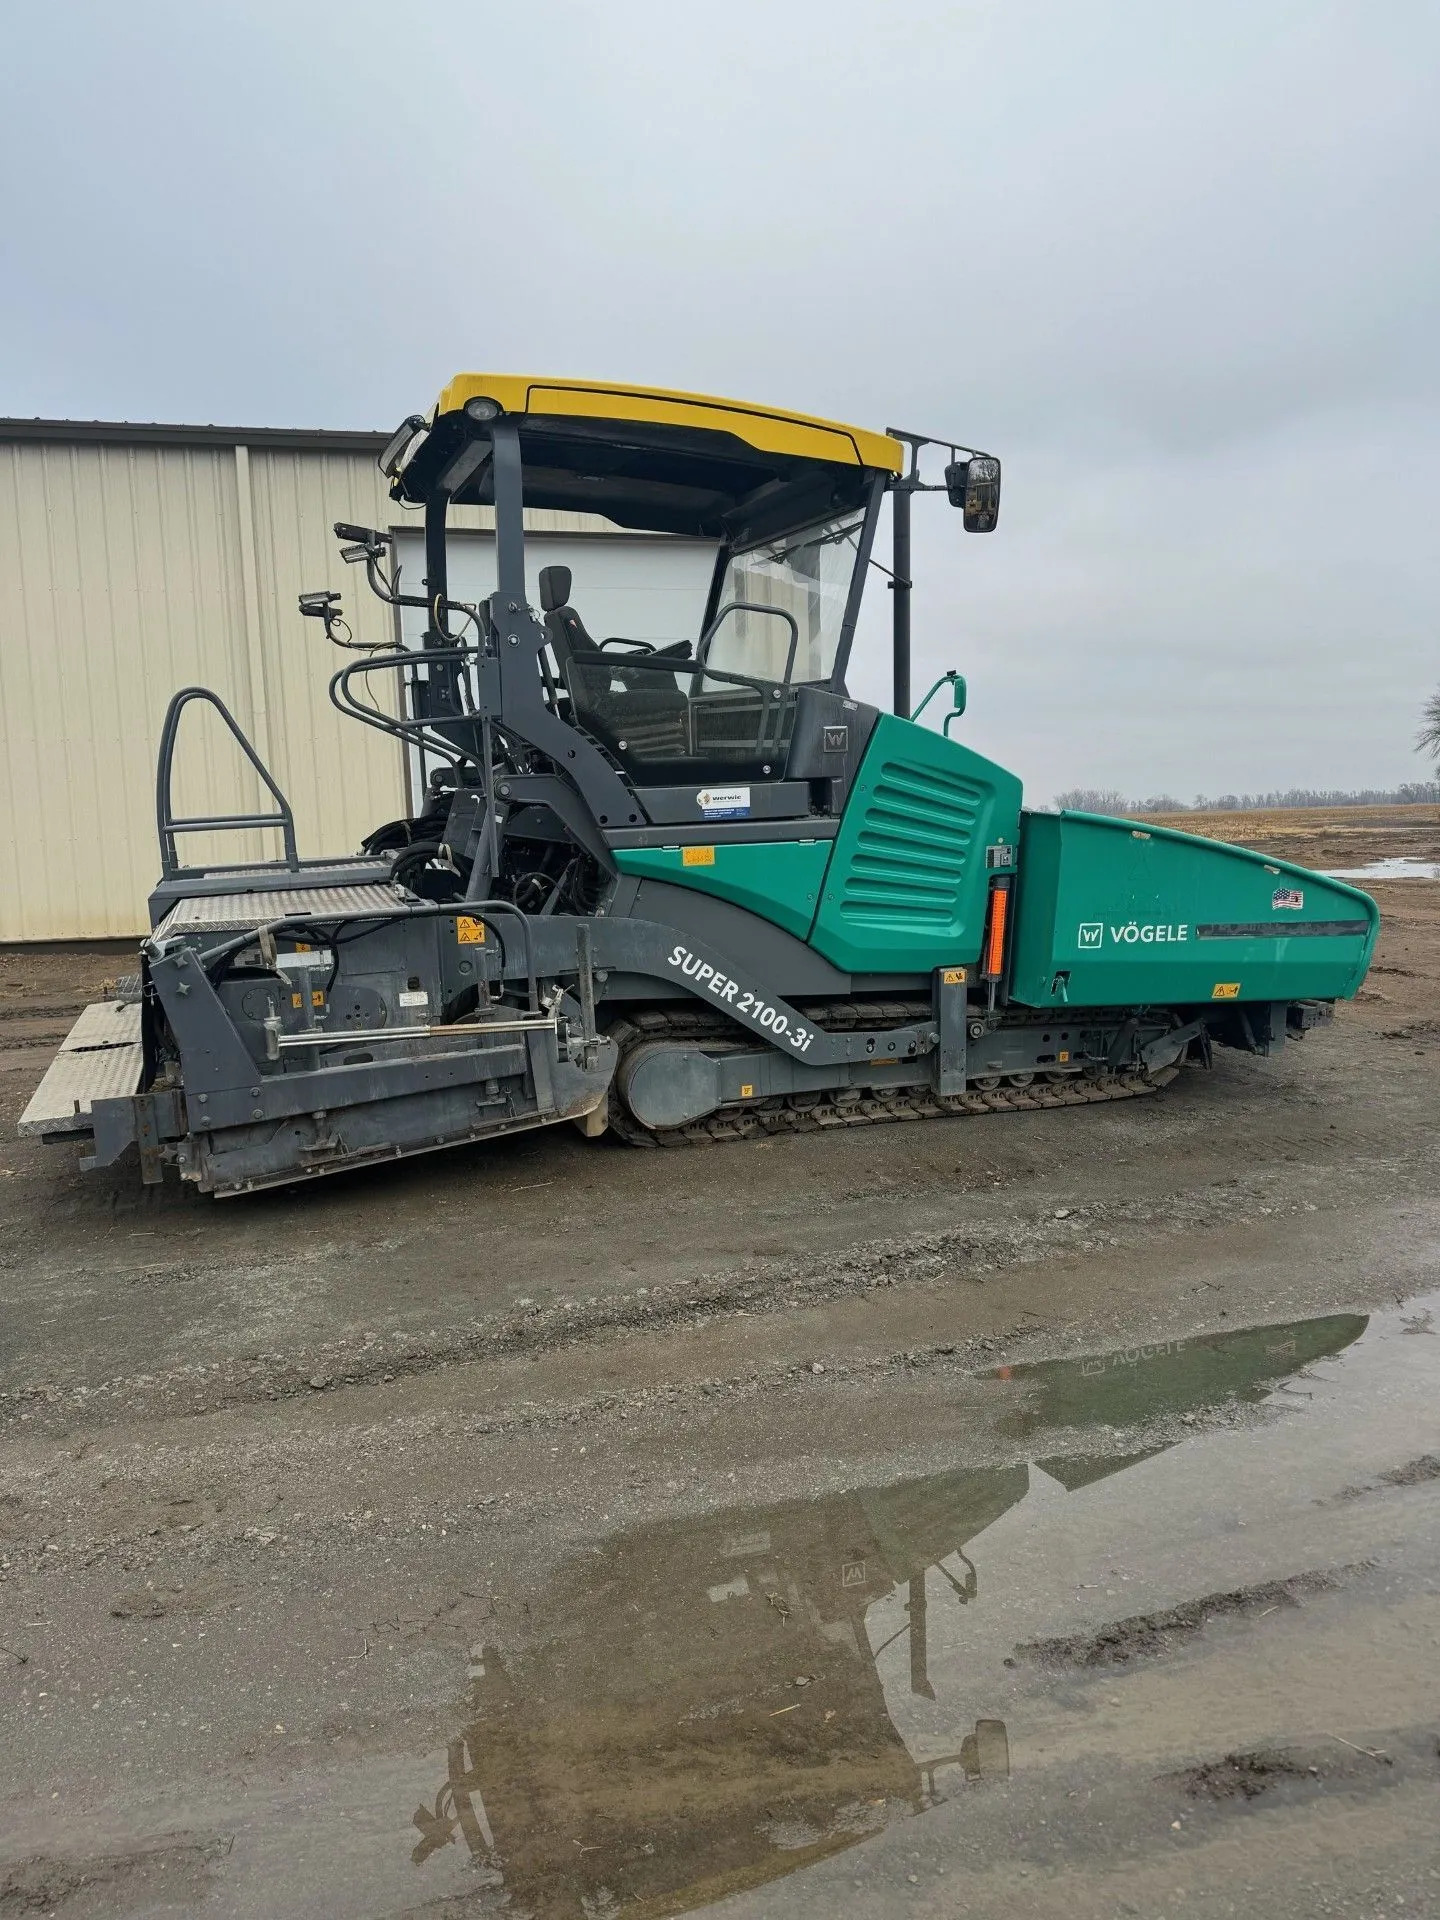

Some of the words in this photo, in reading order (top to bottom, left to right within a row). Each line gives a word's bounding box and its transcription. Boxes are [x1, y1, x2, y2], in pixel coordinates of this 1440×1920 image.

[1110, 921, 1188, 943] VÖGELE
[667, 946, 739, 1002] SUPER
[736, 992, 815, 1052] 2100-3i
